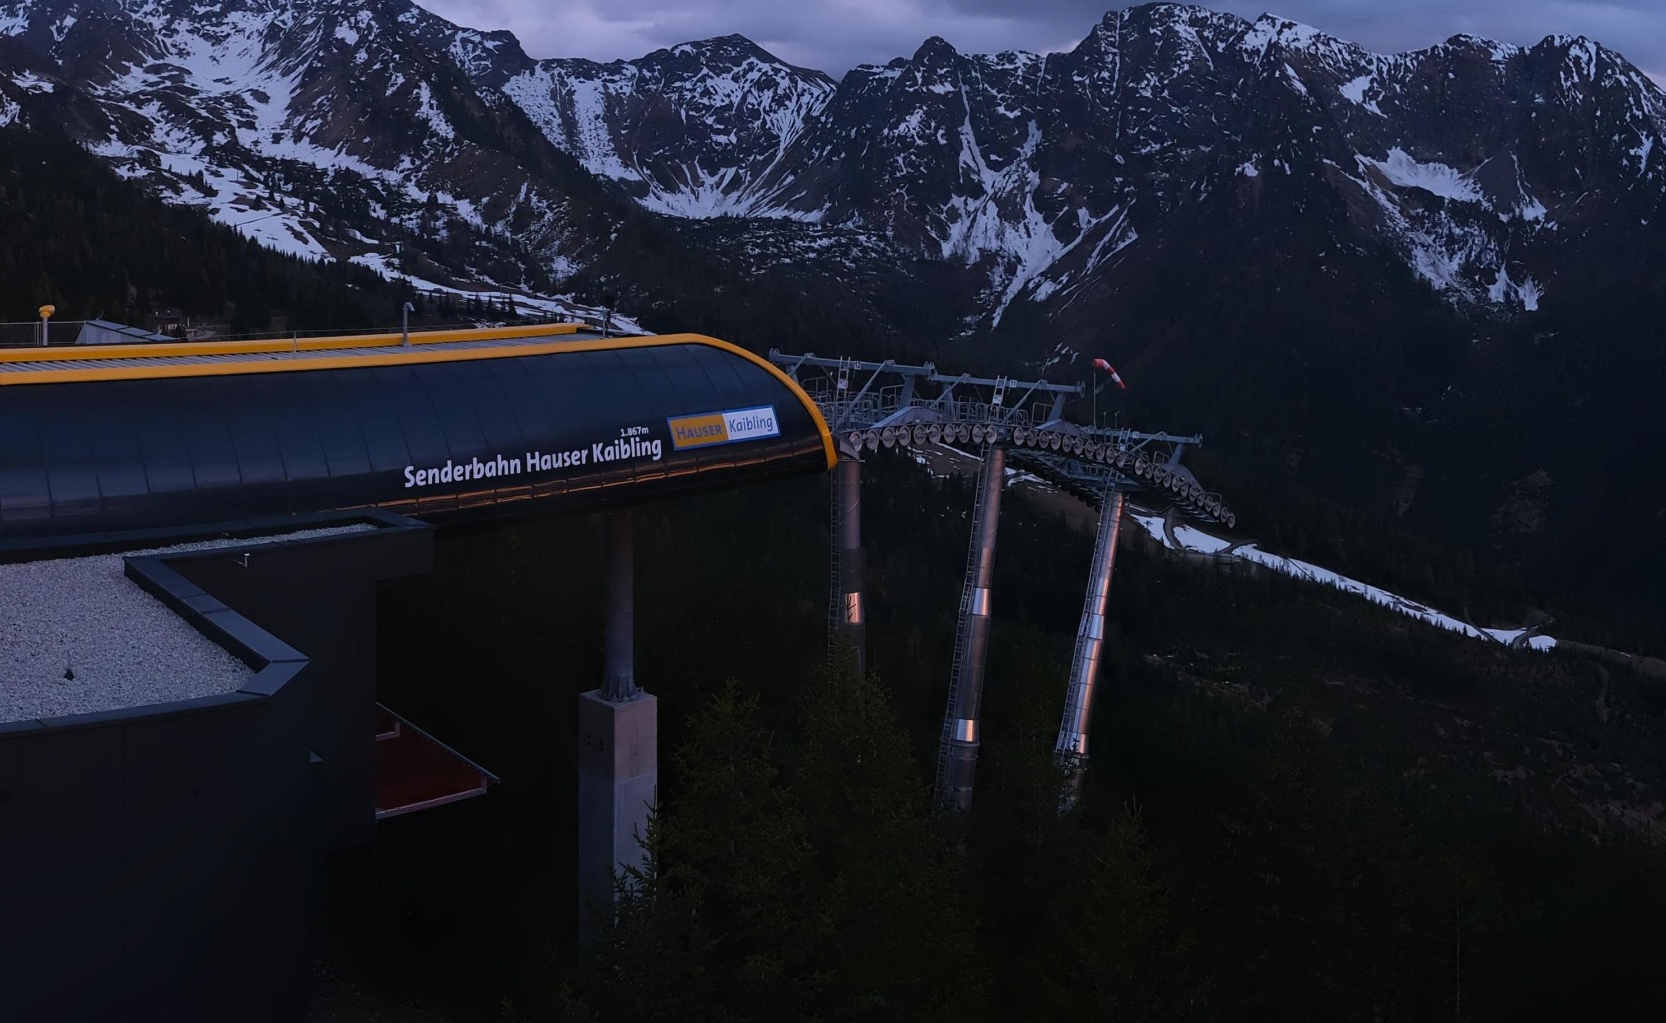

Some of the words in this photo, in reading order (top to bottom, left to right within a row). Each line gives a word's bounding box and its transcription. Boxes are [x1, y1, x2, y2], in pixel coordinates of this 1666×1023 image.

[620, 426, 649, 437] 1.867m
[676, 424, 723, 440] HAUSER
[729, 415, 773, 433] Kaibling
[404, 454, 521, 488] Senderbahn
[526, 448, 588, 473] Hauser
[592, 437, 662, 463] Kaibling
